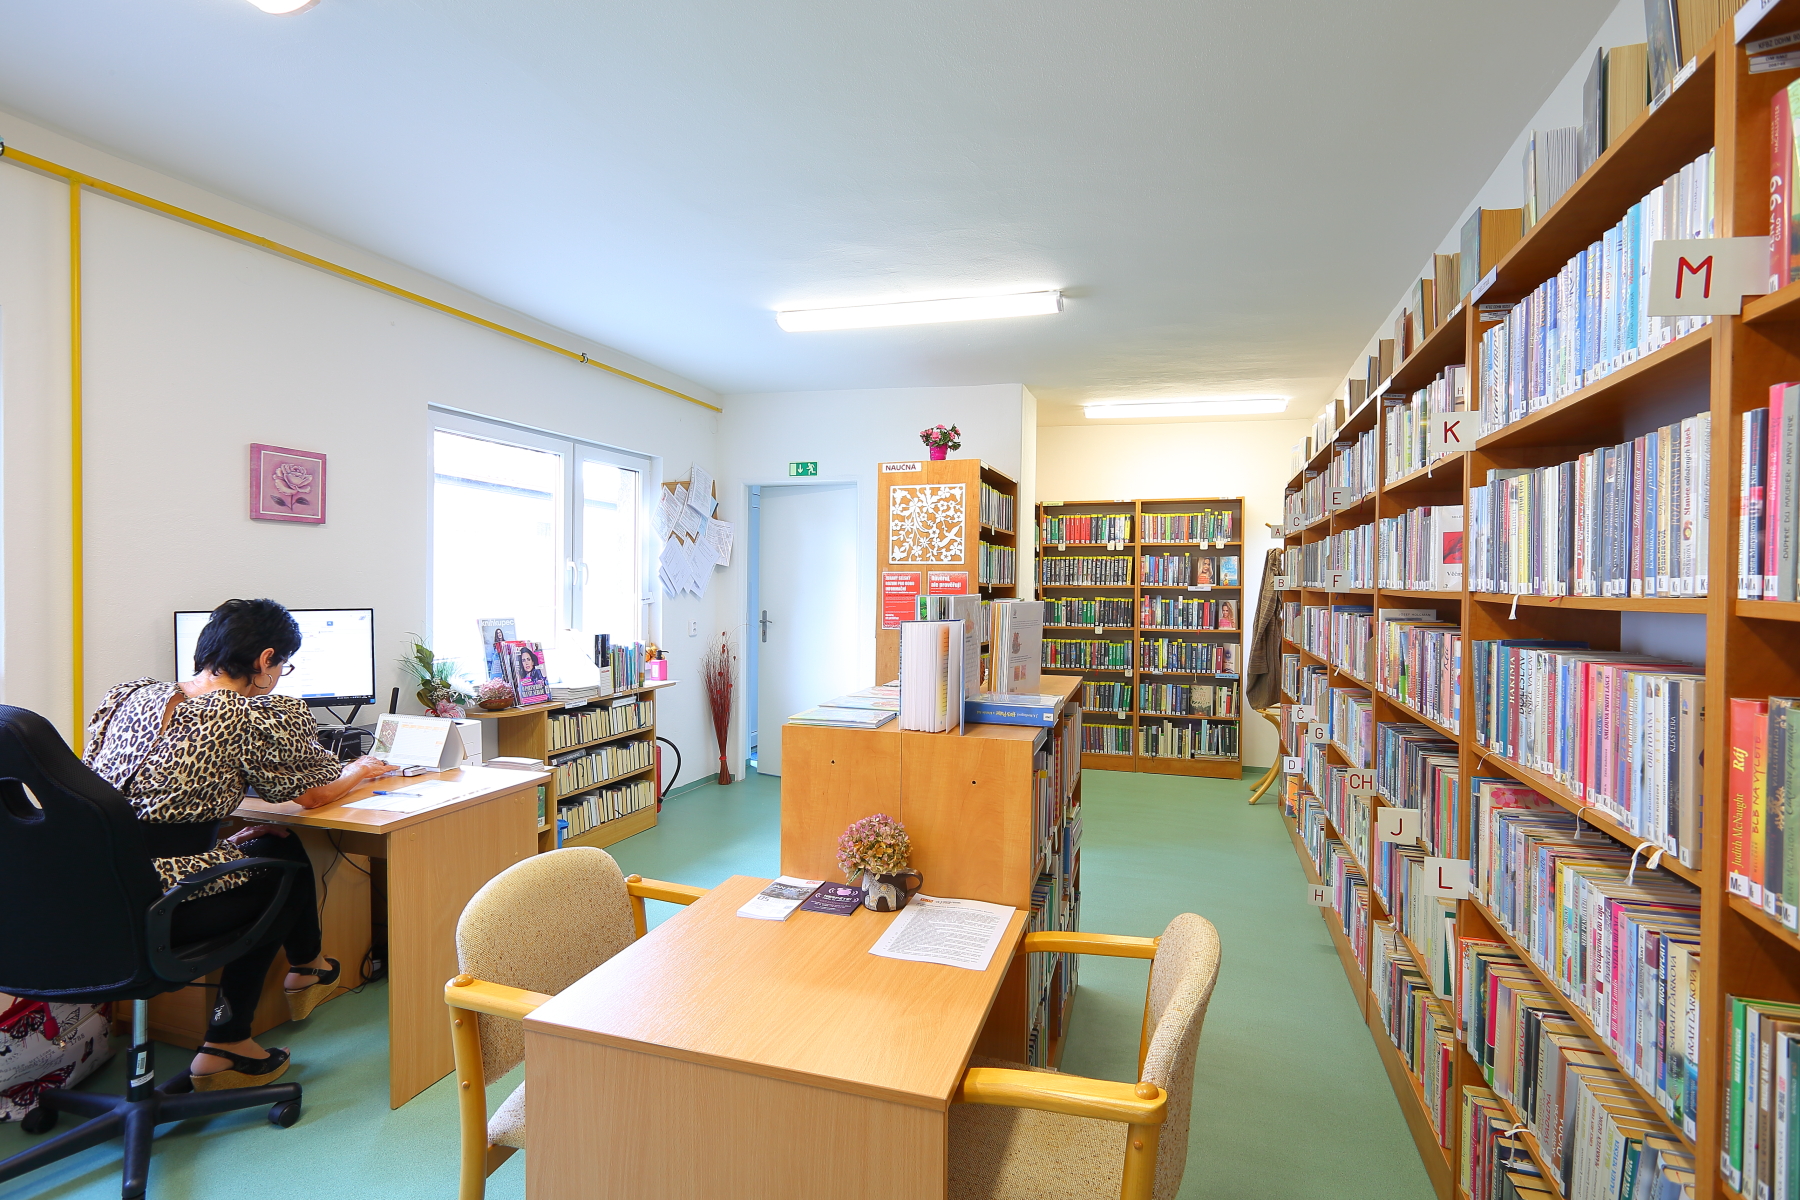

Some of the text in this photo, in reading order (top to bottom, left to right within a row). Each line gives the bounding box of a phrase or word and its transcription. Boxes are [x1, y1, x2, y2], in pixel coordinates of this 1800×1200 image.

[1770, 175, 1782, 210] 99
[1675, 256, 1713, 299] M
[1444, 420, 1460, 443] K
[885, 463, 916, 471] NAUČNÁ
[1333, 492, 1341, 505] E
[1293, 517, 1300, 526] C
[1784, 512, 1790, 522] DU
[1275, 528, 1280, 536] A
[1278, 579, 1284, 587] B
[1333, 575, 1342, 587] F
[481, 619, 515, 627] knihkupec
[1297, 707, 1304, 719] Č
[1315, 728, 1323, 739] G
[1288, 760, 1296, 770] D
[1349, 774, 1373, 790] CH
[1751, 787, 1760, 805] NA
[1731, 747, 1749, 867] Judith McNaught Ráj
[1390, 818, 1402, 836] J
[1751, 810, 1759, 834] BLB
[1438, 866, 1453, 890] L
[1315, 889, 1323, 902] H
[1596, 922, 1603, 931] do
[1596, 933, 1605, 973] Vstupenka
